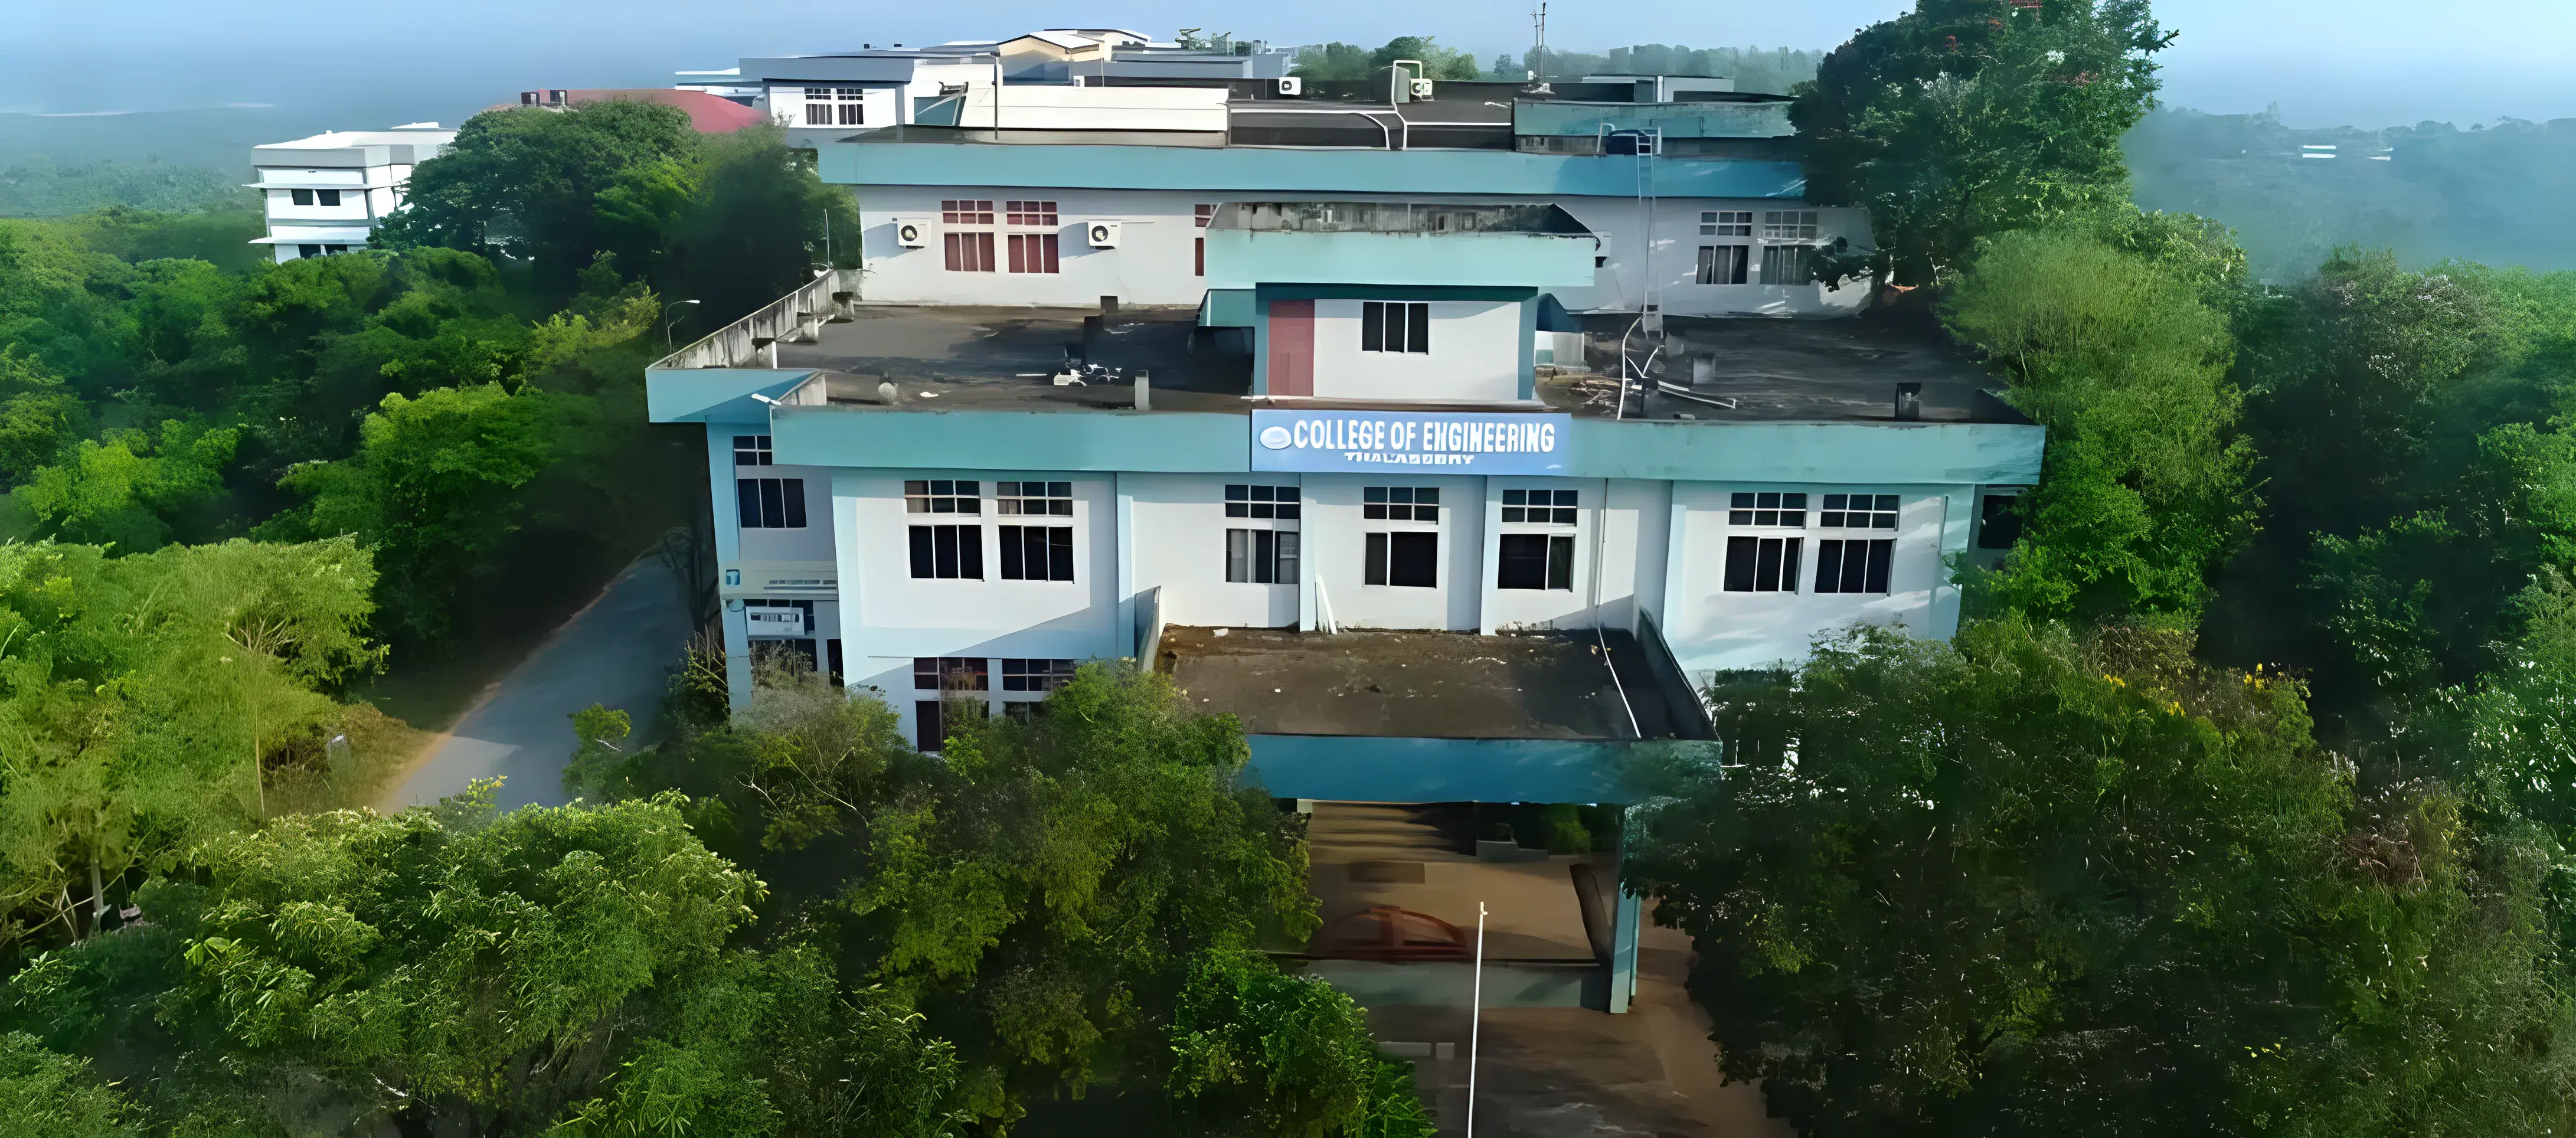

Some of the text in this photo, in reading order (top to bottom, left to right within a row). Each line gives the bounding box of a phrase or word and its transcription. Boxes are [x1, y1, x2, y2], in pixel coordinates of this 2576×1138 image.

[1293, 419, 1555, 453] COLLEGE OF ENGINEERING
